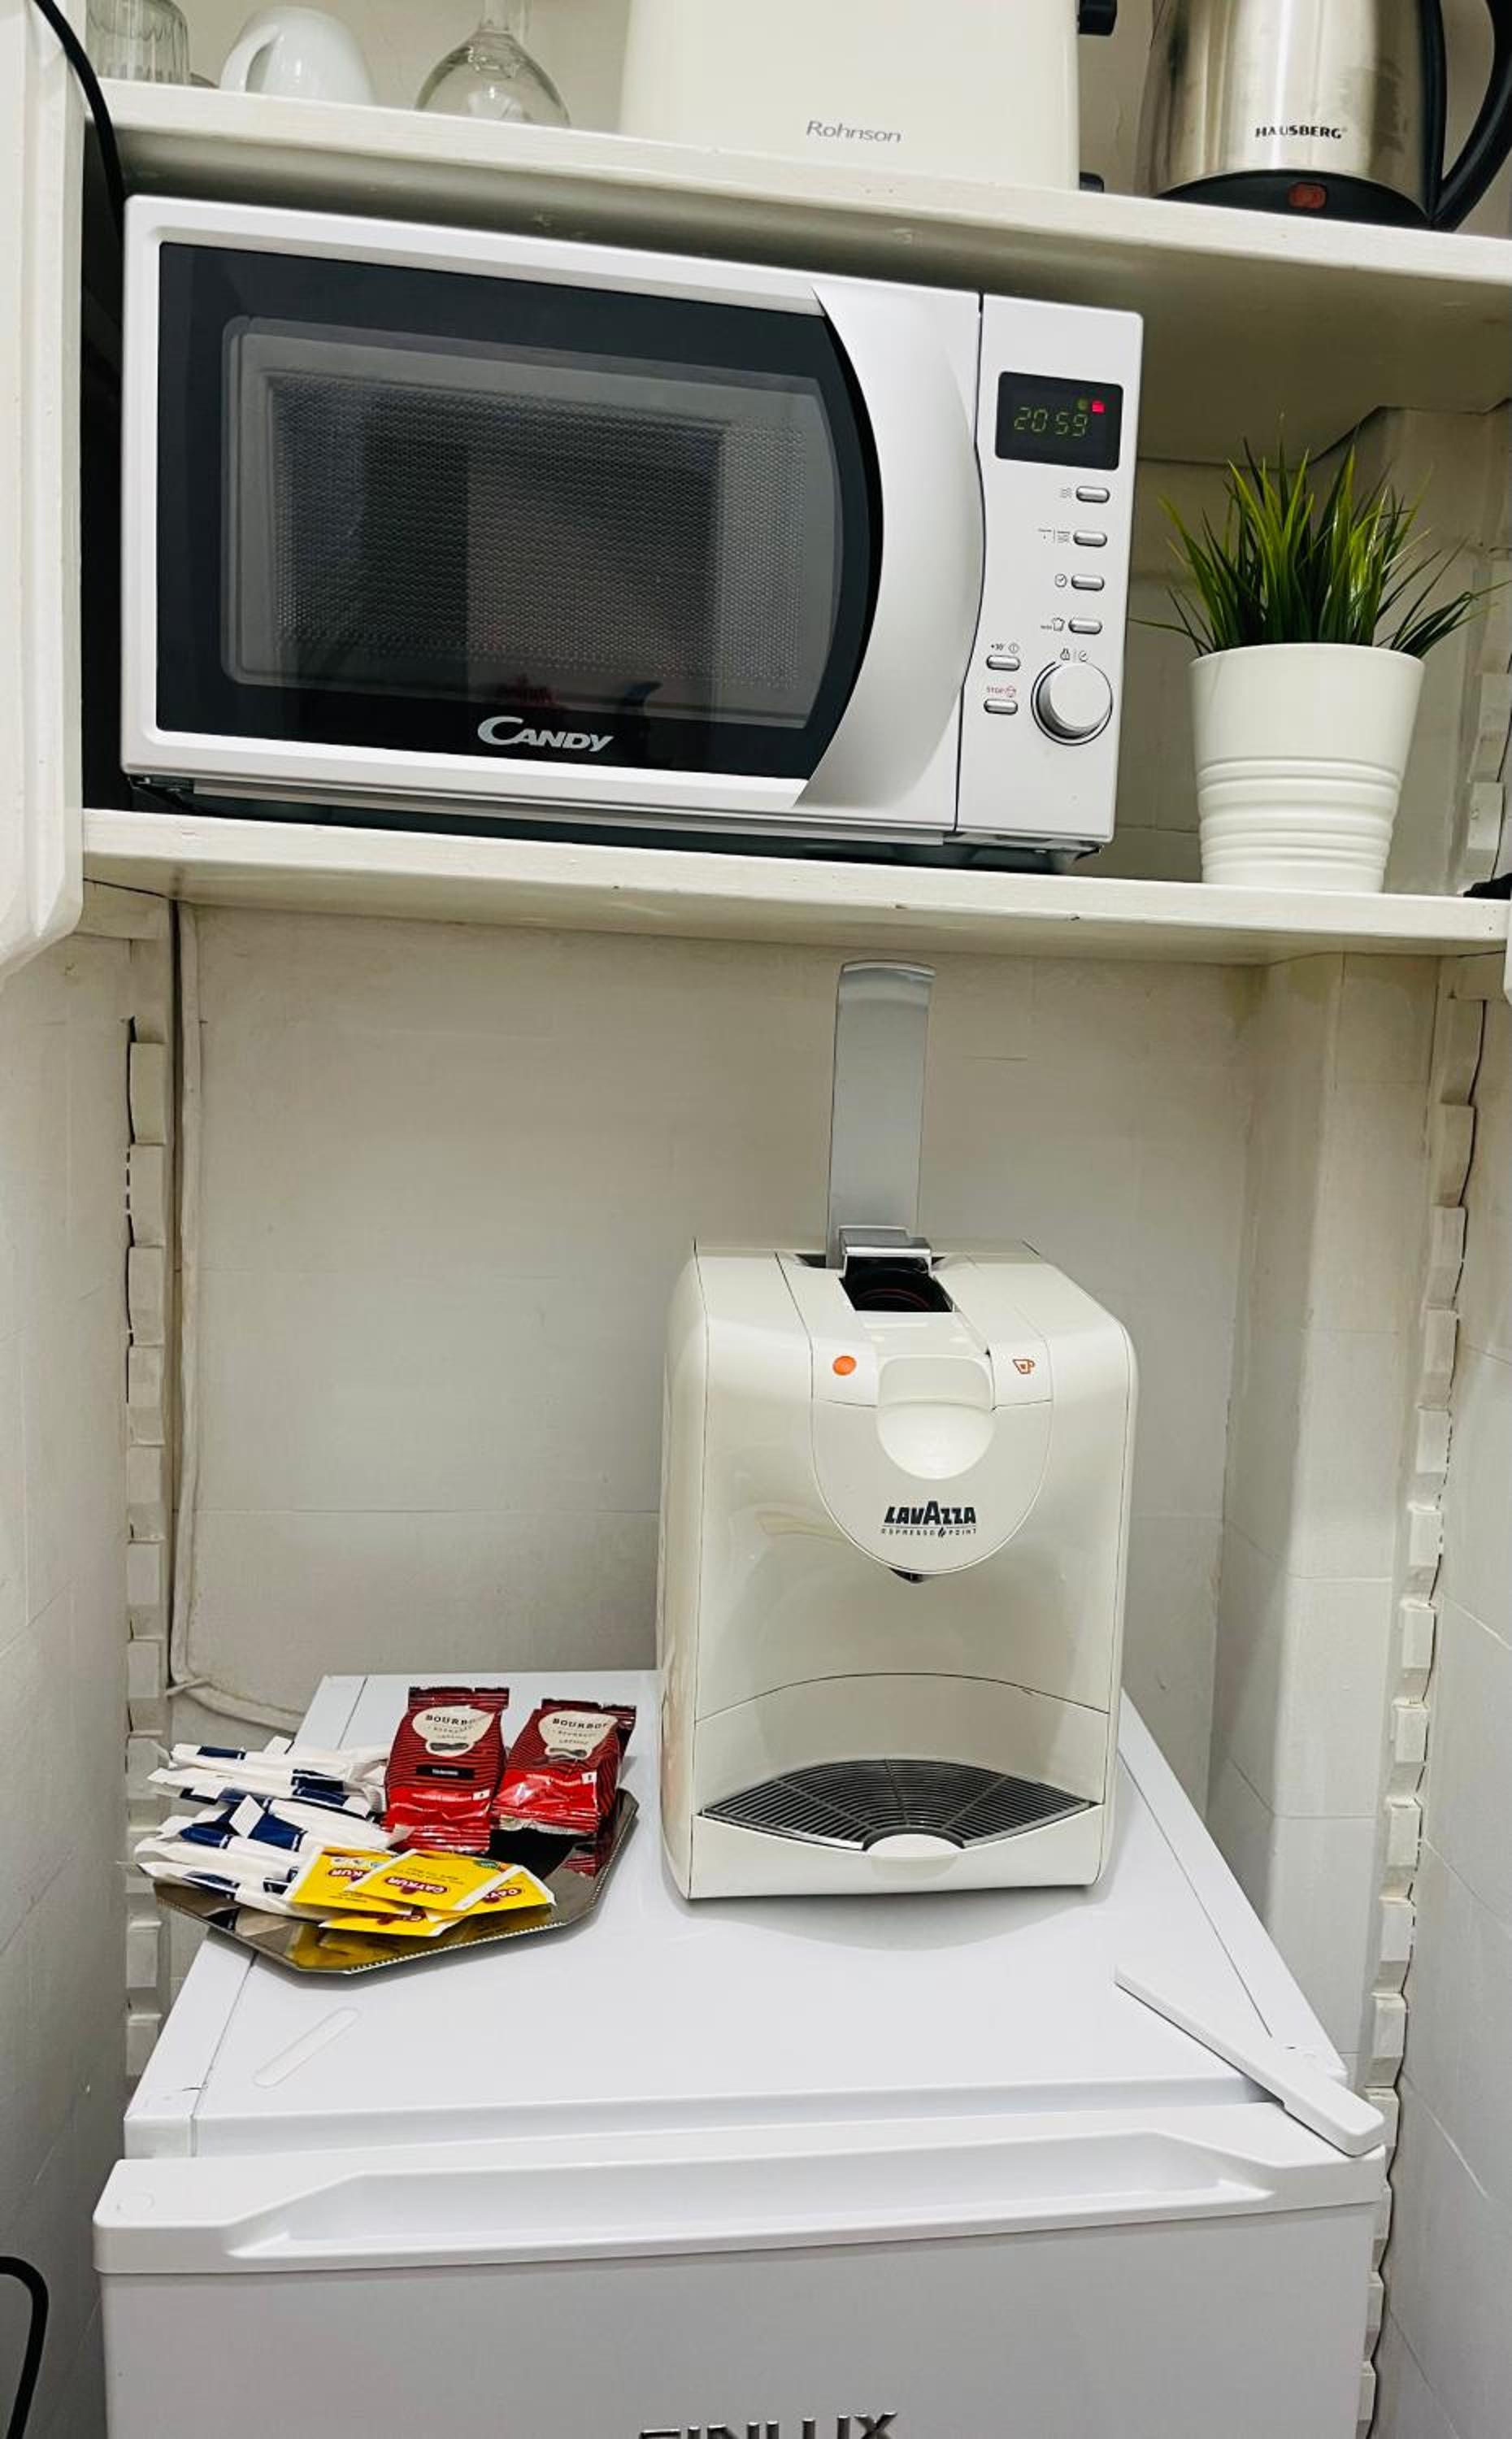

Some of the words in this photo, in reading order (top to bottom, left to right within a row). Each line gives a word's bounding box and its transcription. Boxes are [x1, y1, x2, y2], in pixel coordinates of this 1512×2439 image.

[806, 120, 902, 143] Rohnson
[1255, 124, 1342, 139] HAUSBERG
[477, 715, 615, 752] CANDY
[884, 1501, 976, 1525] LAVAZZA
